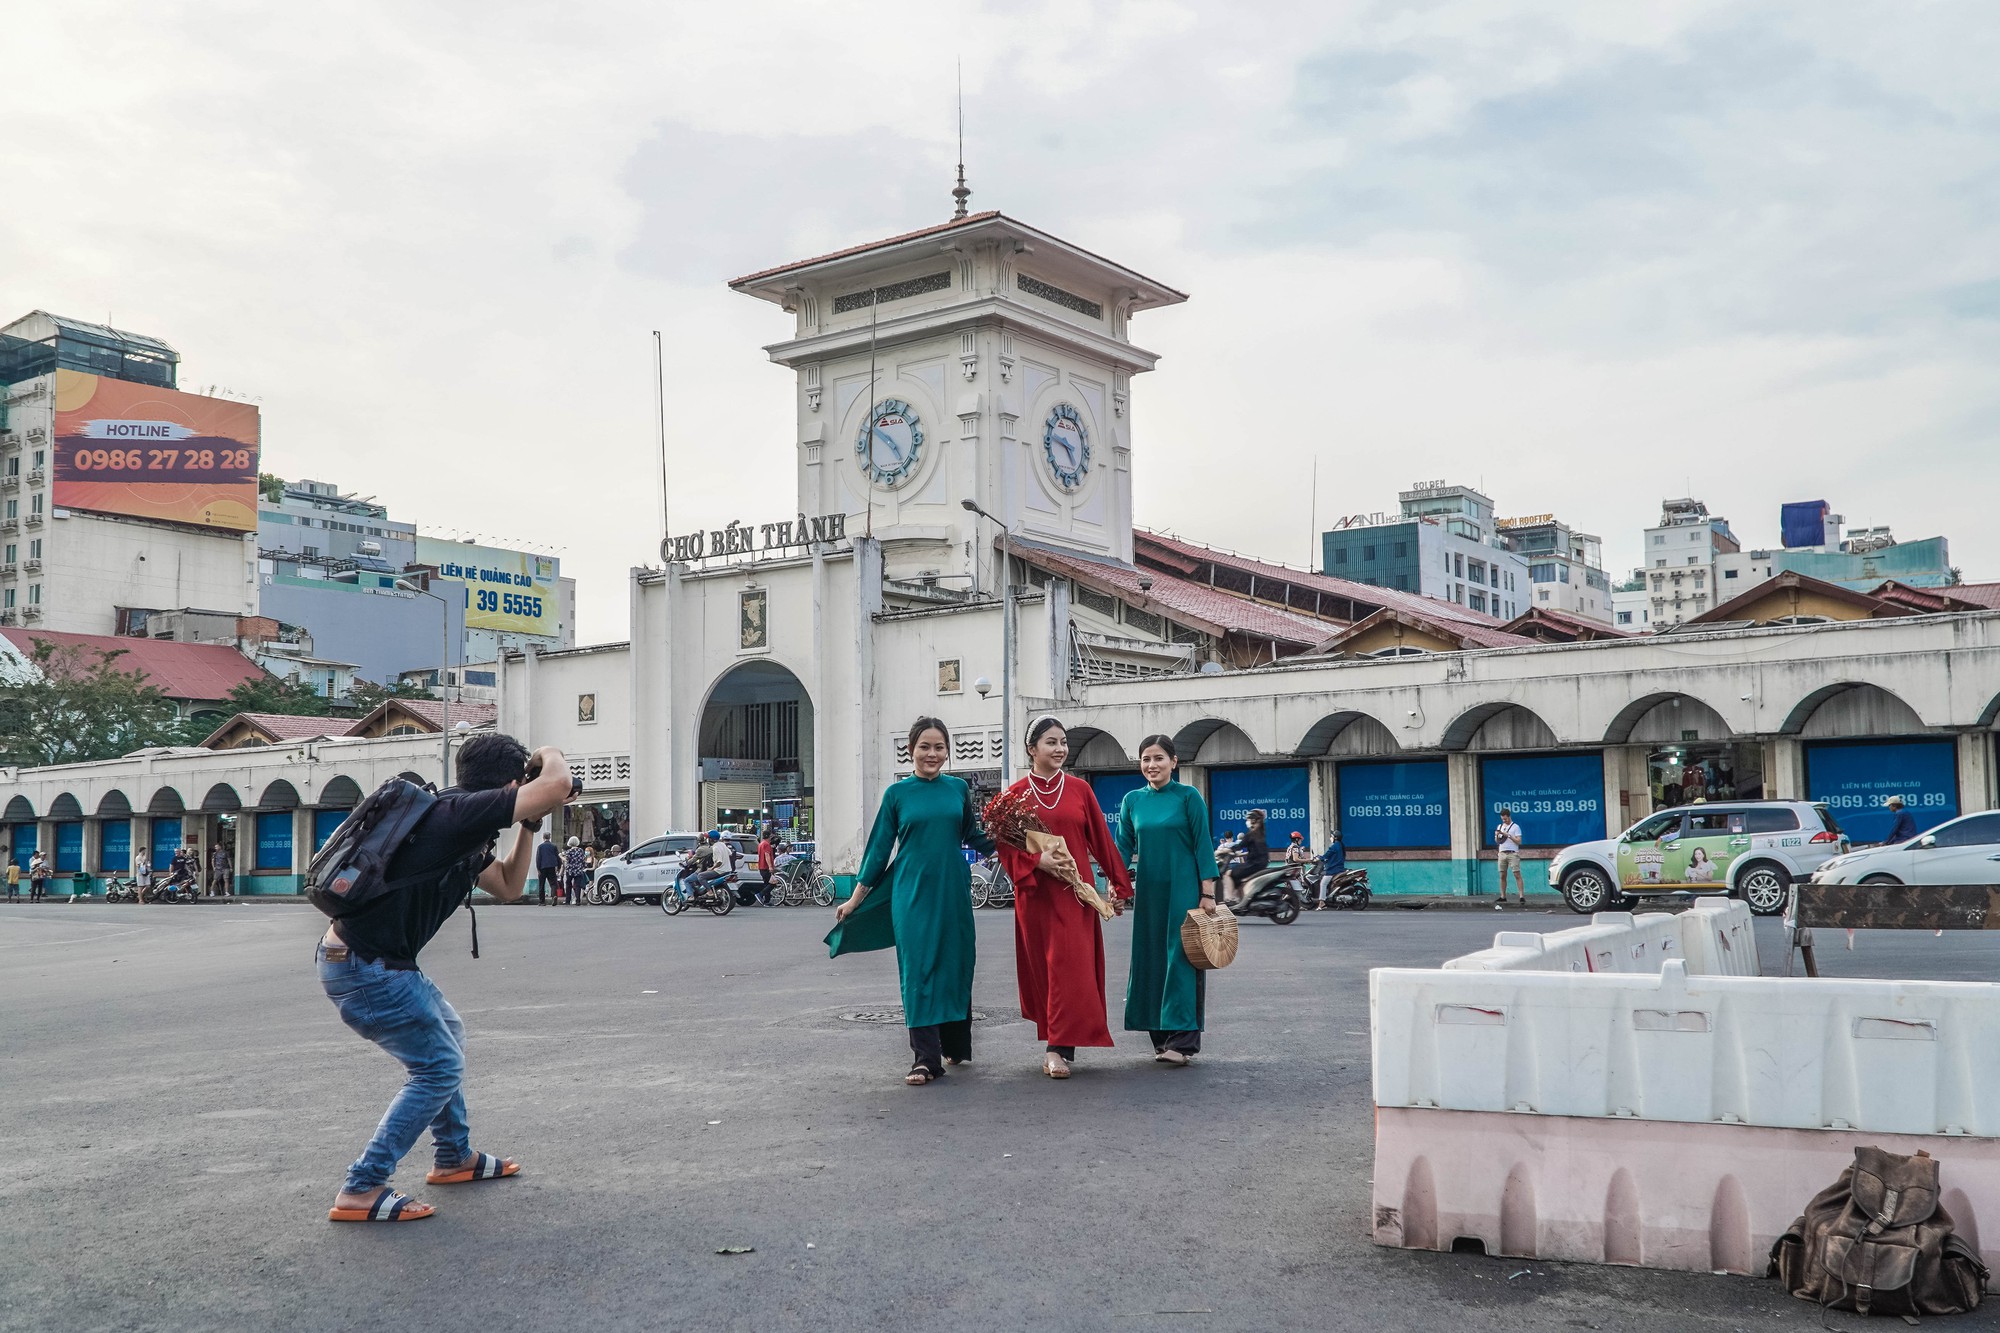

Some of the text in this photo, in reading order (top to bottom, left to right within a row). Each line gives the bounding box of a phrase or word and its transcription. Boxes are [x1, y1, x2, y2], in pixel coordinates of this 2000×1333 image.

[106, 424, 170, 437] HOTLINE
[74, 449, 250, 471] 0986 27 28 28
[1412, 479, 1446, 491] GOLDEN
[1333, 512, 1386, 530] AVANTI
[1520, 513, 1554, 526] ROOFTOP
[660, 512, 847, 563] CHỢ BẾN THÀNH
[441, 562, 463, 578] LIÊN
[465, 565, 478, 583] HỆ
[480, 566, 512, 585] QUẢNG
[477, 589, 498, 613] 39
[503, 592, 542, 618] 5555
[1841, 779, 1921, 790] LIÊN HỆ QUẢNG CÁO
[1380, 793, 1388, 801] HỆ
[1389, 792, 1411, 801] QUẢNG
[1511, 788, 1527, 797] LIÊN
[1527, 788, 1537, 797] HỆ
[1538, 786, 1562, 796] QUẢNG
[1248, 797, 1256, 805] HỆ
[1256, 796, 1277, 805] QUẢNG
[1348, 803, 1443, 818] 0969.39.89.89
[1782, 838, 1801, 847] 1022
[1634, 855, 1665, 863] BEONE
